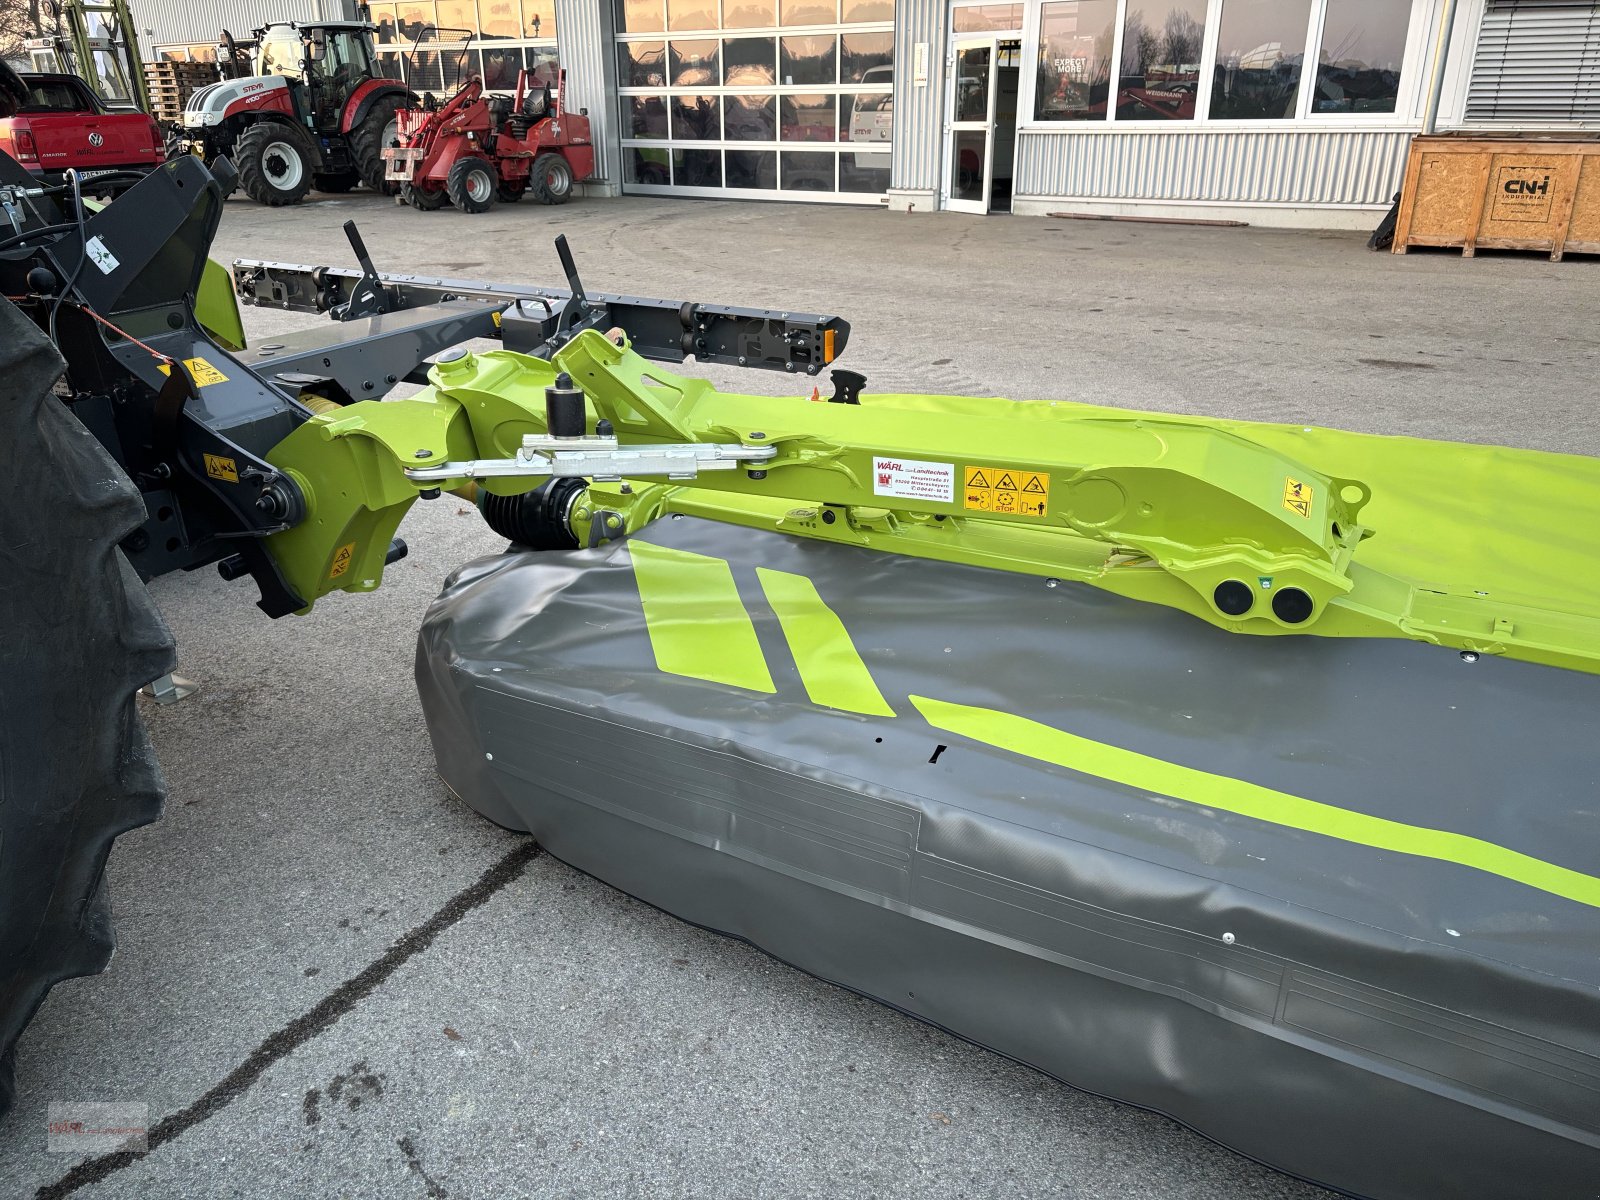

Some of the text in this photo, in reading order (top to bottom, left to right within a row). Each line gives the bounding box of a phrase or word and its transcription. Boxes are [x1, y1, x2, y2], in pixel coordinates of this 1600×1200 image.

[1054, 58, 1086, 67] EXPECT
[1057, 65, 1082, 73] MORE
[243, 83, 264, 93] STEYR
[1145, 89, 1183, 99] WEIDEMANN
[245, 95, 260, 104] 4100
[877, 461, 949, 477] WÄRL Landtechnik
[995, 505, 1015, 513] STOP
